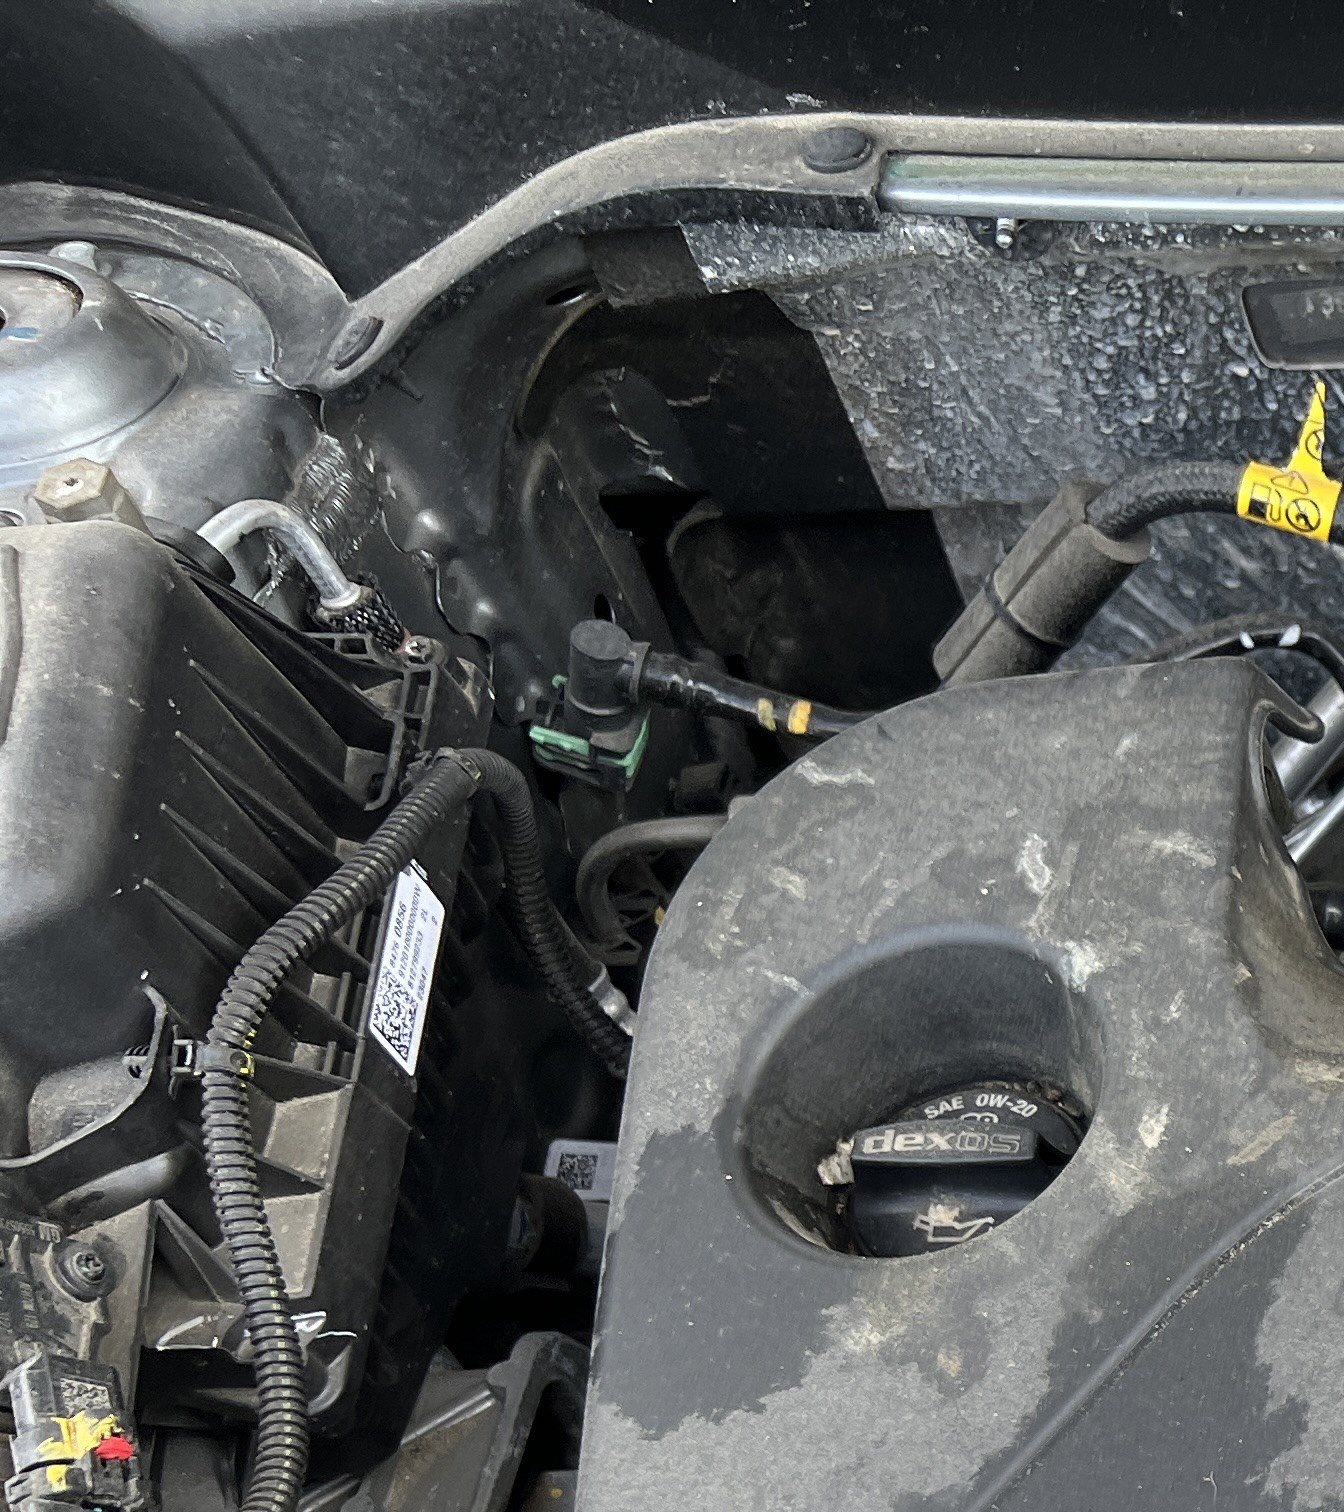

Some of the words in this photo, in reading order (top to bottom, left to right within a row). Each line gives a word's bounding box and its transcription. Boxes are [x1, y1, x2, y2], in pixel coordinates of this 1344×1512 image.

[924, 1095, 965, 1119] SAE
[976, 1093, 1039, 1118] 0W-20
[862, 1129, 1021, 1154] dexos
